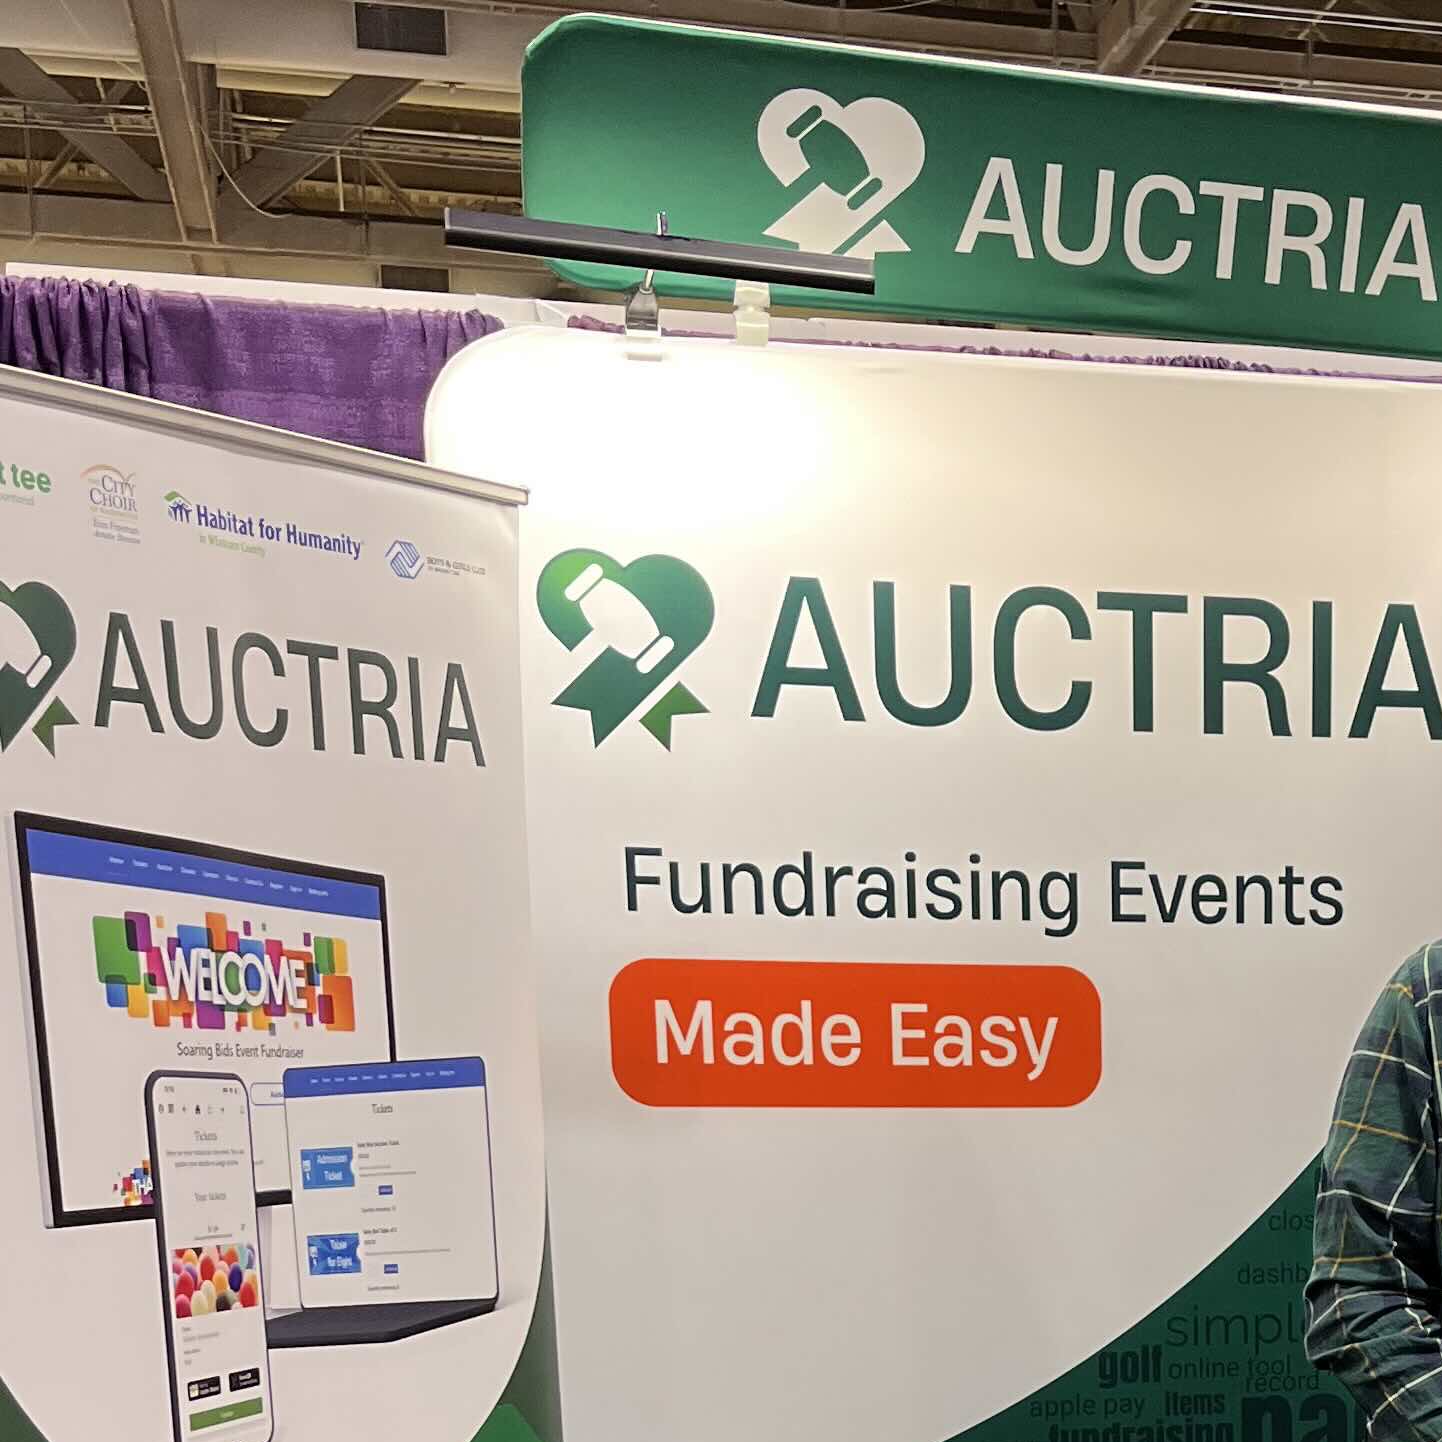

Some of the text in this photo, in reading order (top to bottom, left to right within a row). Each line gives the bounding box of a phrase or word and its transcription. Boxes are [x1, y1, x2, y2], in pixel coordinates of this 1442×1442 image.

[954, 157, 1438, 301] AUCTRIA
[11, 463, 51, 492] tee
[196, 504, 360, 560] Habitat for Humanity
[95, 611, 486, 767] AUCTRIA
[624, 846, 1345, 938] Fundraising Events
[163, 947, 307, 1009] WELCOME
[177, 1041, 304, 1060] Soaring Bids Event Fundraiser
[654, 999, 1060, 1081] Made Easy
[1166, 1304, 1304, 1354] simpl
[1100, 1345, 1162, 1388] golf
[1168, 1358, 1239, 1380] online
[1246, 1371, 1320, 1393] record
[1030, 1394, 1145, 1420] apple pay
